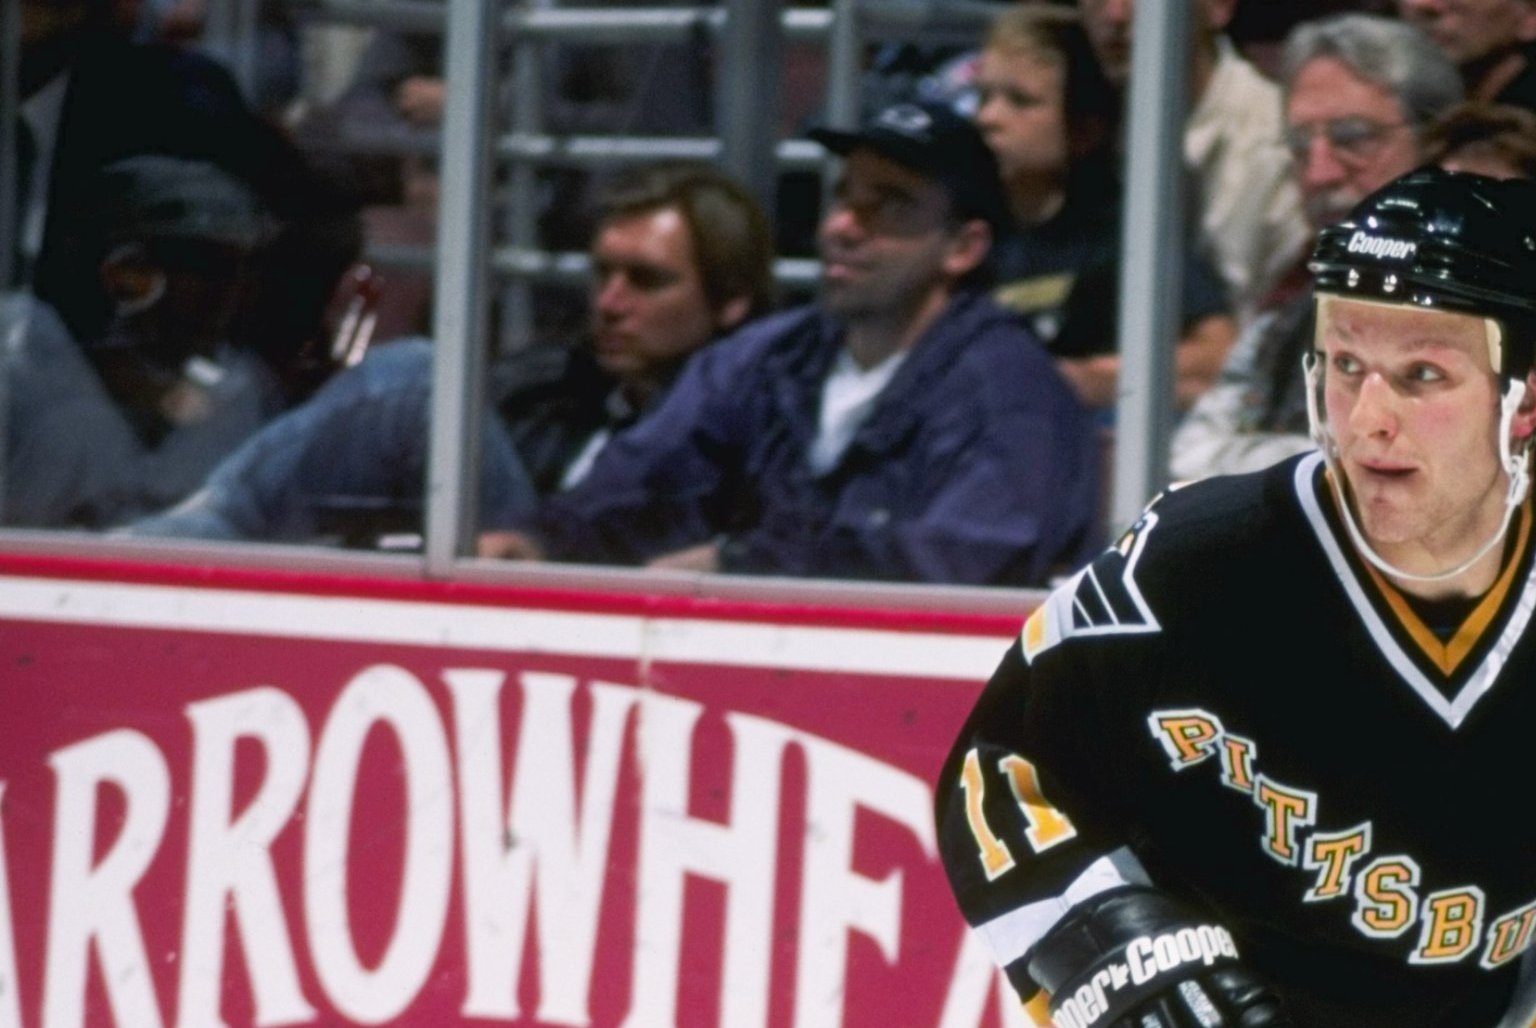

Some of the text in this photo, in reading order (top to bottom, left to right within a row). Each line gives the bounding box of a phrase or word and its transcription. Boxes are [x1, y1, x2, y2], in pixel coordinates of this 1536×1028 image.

[1348, 231, 1416, 260] Cooper
[959, 747, 1077, 881] 11
[1126, 924, 1239, 986] Coope
